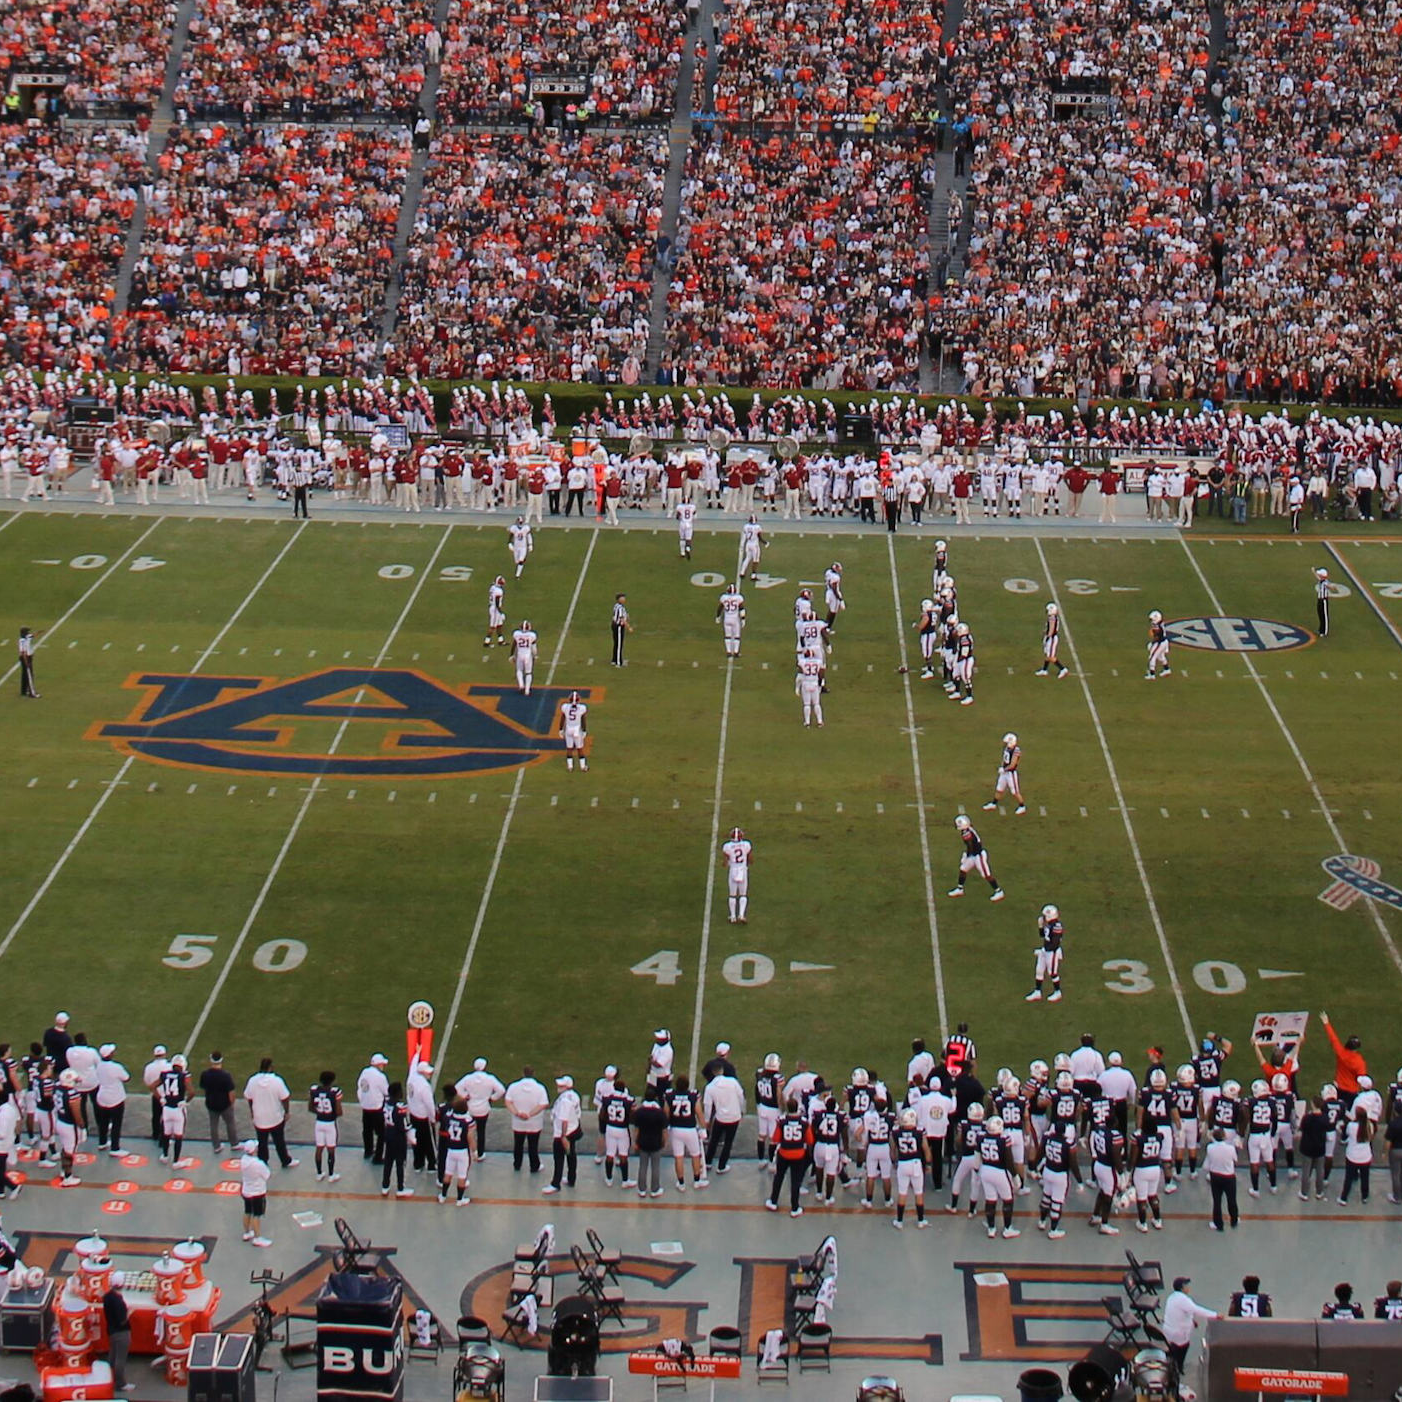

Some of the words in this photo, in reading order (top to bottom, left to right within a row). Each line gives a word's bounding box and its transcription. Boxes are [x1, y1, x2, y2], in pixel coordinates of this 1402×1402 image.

[684, 509, 691, 520] 8
[70, 554, 167, 572] 40
[378, 564, 474, 583] 50
[1003, 578, 1099, 596] 30
[724, 600, 738, 612] 35
[804, 626, 818, 639] 58
[1164, 618, 1301, 651] SEC
[518, 638, 530, 648] 21
[804, 663, 818, 676] 33
[568, 708, 577, 721] 5
[734, 849, 744, 864] 2
[161, 934, 308, 972] 50
[629, 949, 776, 987] 40
[1102, 958, 1247, 995] 30
[412, 1008, 430, 1024] SEC
[948, 1044, 966, 1070] 2
[1200, 1063, 1218, 1079] 24
[165, 1079, 179, 1097] 14
[314, 1098, 332, 1114] 39
[672, 1101, 692, 1117] 73
[854, 1096, 870, 1112] 19
[1148, 1099, 1166, 1116] 44
[1177, 1096, 1194, 1112] 47
[607, 1107, 626, 1122] 93
[1215, 1106, 1233, 1123] 32
[1252, 1108, 1271, 1125] 22
[448, 1125, 463, 1141] 47
[783, 1125, 802, 1141] 85
[819, 1119, 838, 1136] 43
[898, 1137, 918, 1153] 53
[981, 1143, 999, 1162] 56
[1142, 1141, 1160, 1158] 50
[1045, 1145, 1062, 1163] 65
[116, 1181, 131, 1192] 8
[171, 1180, 186, 1191] 9
[220, 1182, 242, 1193] 10
[107, 1201, 125, 1212] 11
[89, 1275, 102, 1288] G
[161, 1279, 173, 1292] G
[1240, 1299, 1260, 1317] 51
[71, 1318, 84, 1332] G
[168, 1323, 180, 1336] G
[68, 1355, 80, 1368] G
[170, 1359, 182, 1371] G
[1261, 1377, 1323, 1389] GATORADE
[72, 1388, 86, 1402] G
